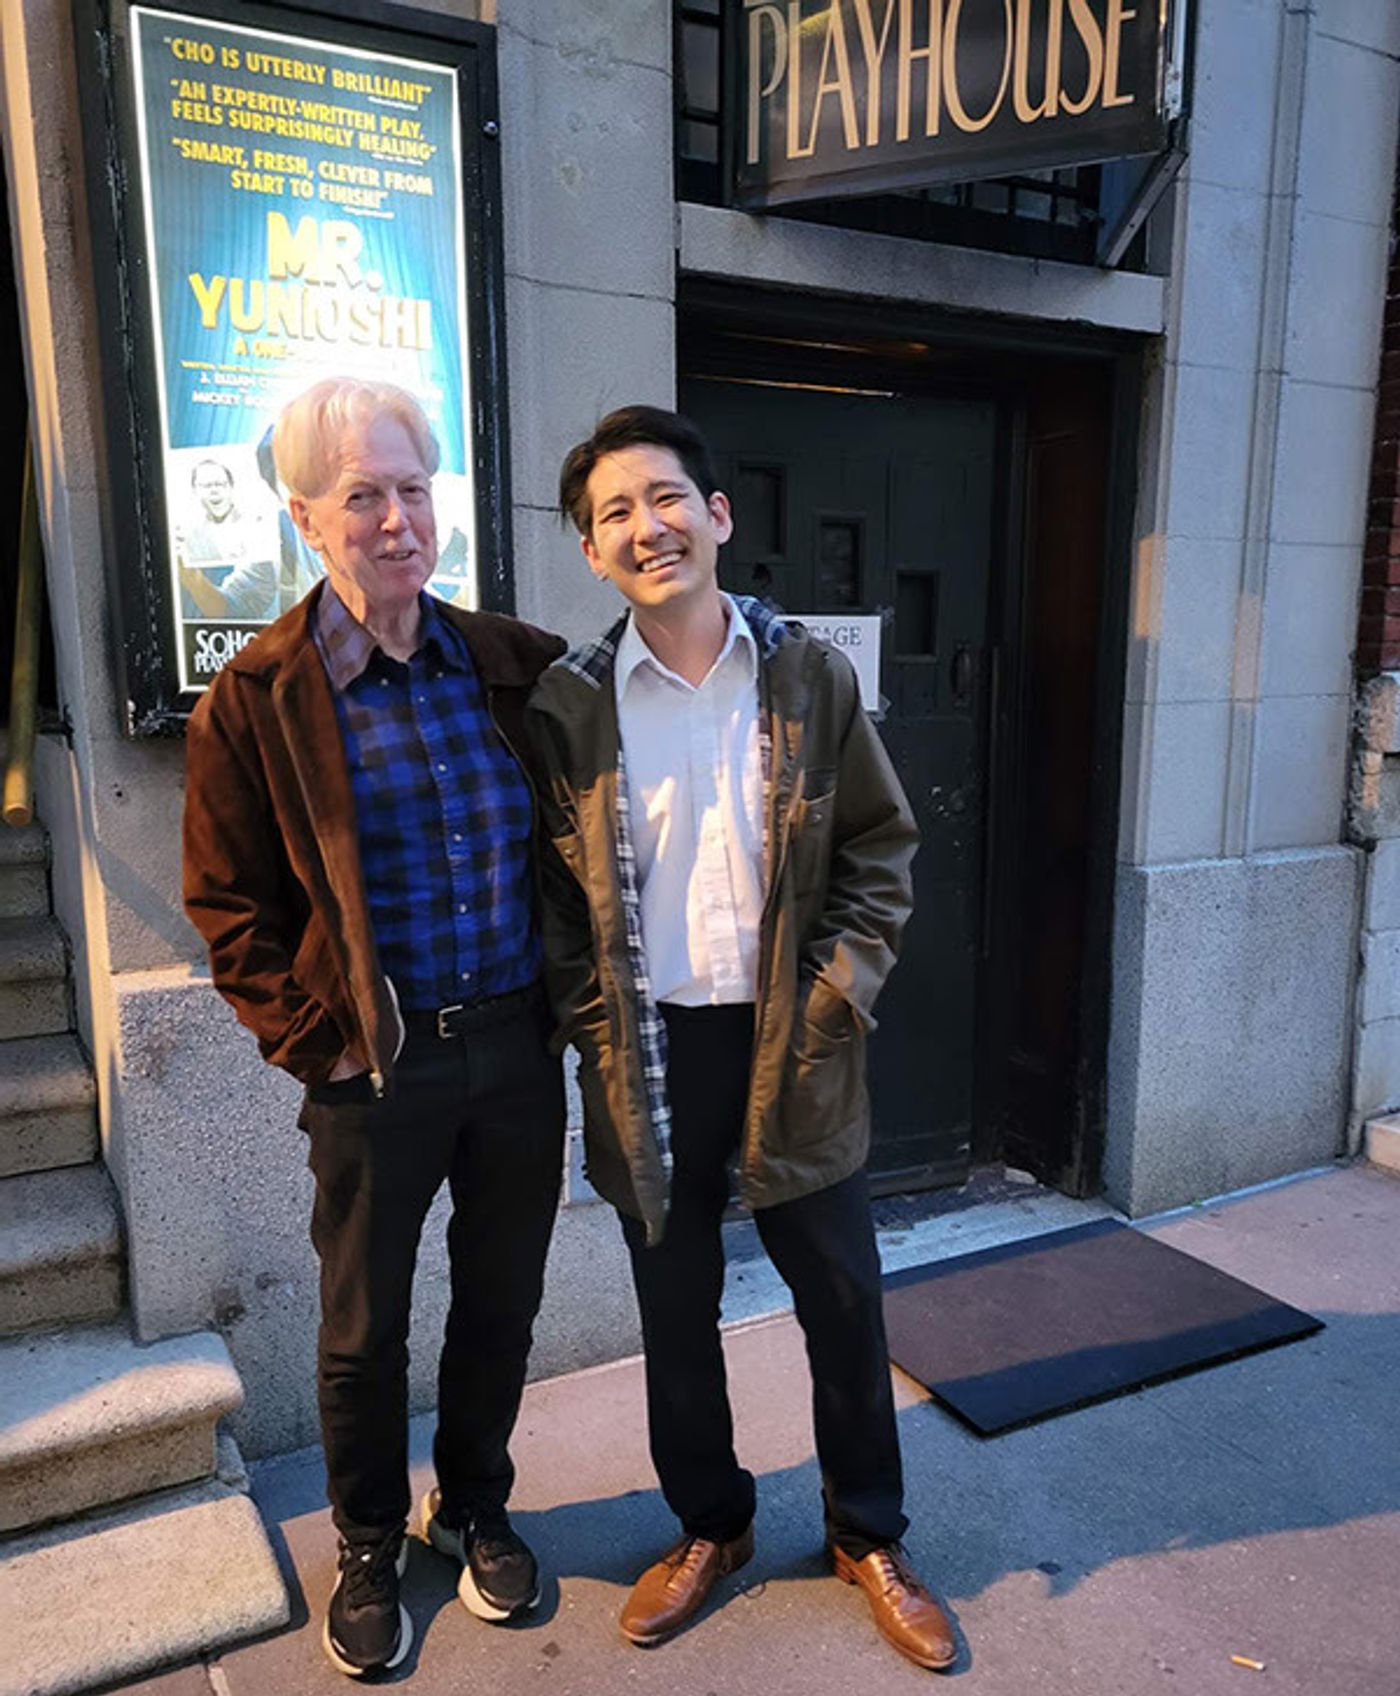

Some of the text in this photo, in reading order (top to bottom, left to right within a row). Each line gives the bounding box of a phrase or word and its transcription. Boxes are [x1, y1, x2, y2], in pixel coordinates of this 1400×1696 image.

[163, 36, 215, 64] "CHO
[220, 47, 241, 69] IS
[245, 51, 326, 85] UTTERLY
[331, 68, 432, 105] BRILLIANT"
[747, 0, 1137, 165] PLAYHOUSE
[170, 79, 207, 101] "AN
[211, 84, 377, 132] EXPERTLY-WRITTEN
[171, 99, 224, 126] FEELS
[228, 108, 354, 148] SURPRISINGLY
[358, 131, 437, 161] HEALING"
[171, 137, 434, 196] "SMART, FRESH, CLEVER FROM
[231, 169, 285, 195] START
[289, 177, 314, 199] TO
[265, 210, 384, 292] MR.
[188, 271, 434, 351] YUNIOSHI
[232, 335, 249, 357] A
